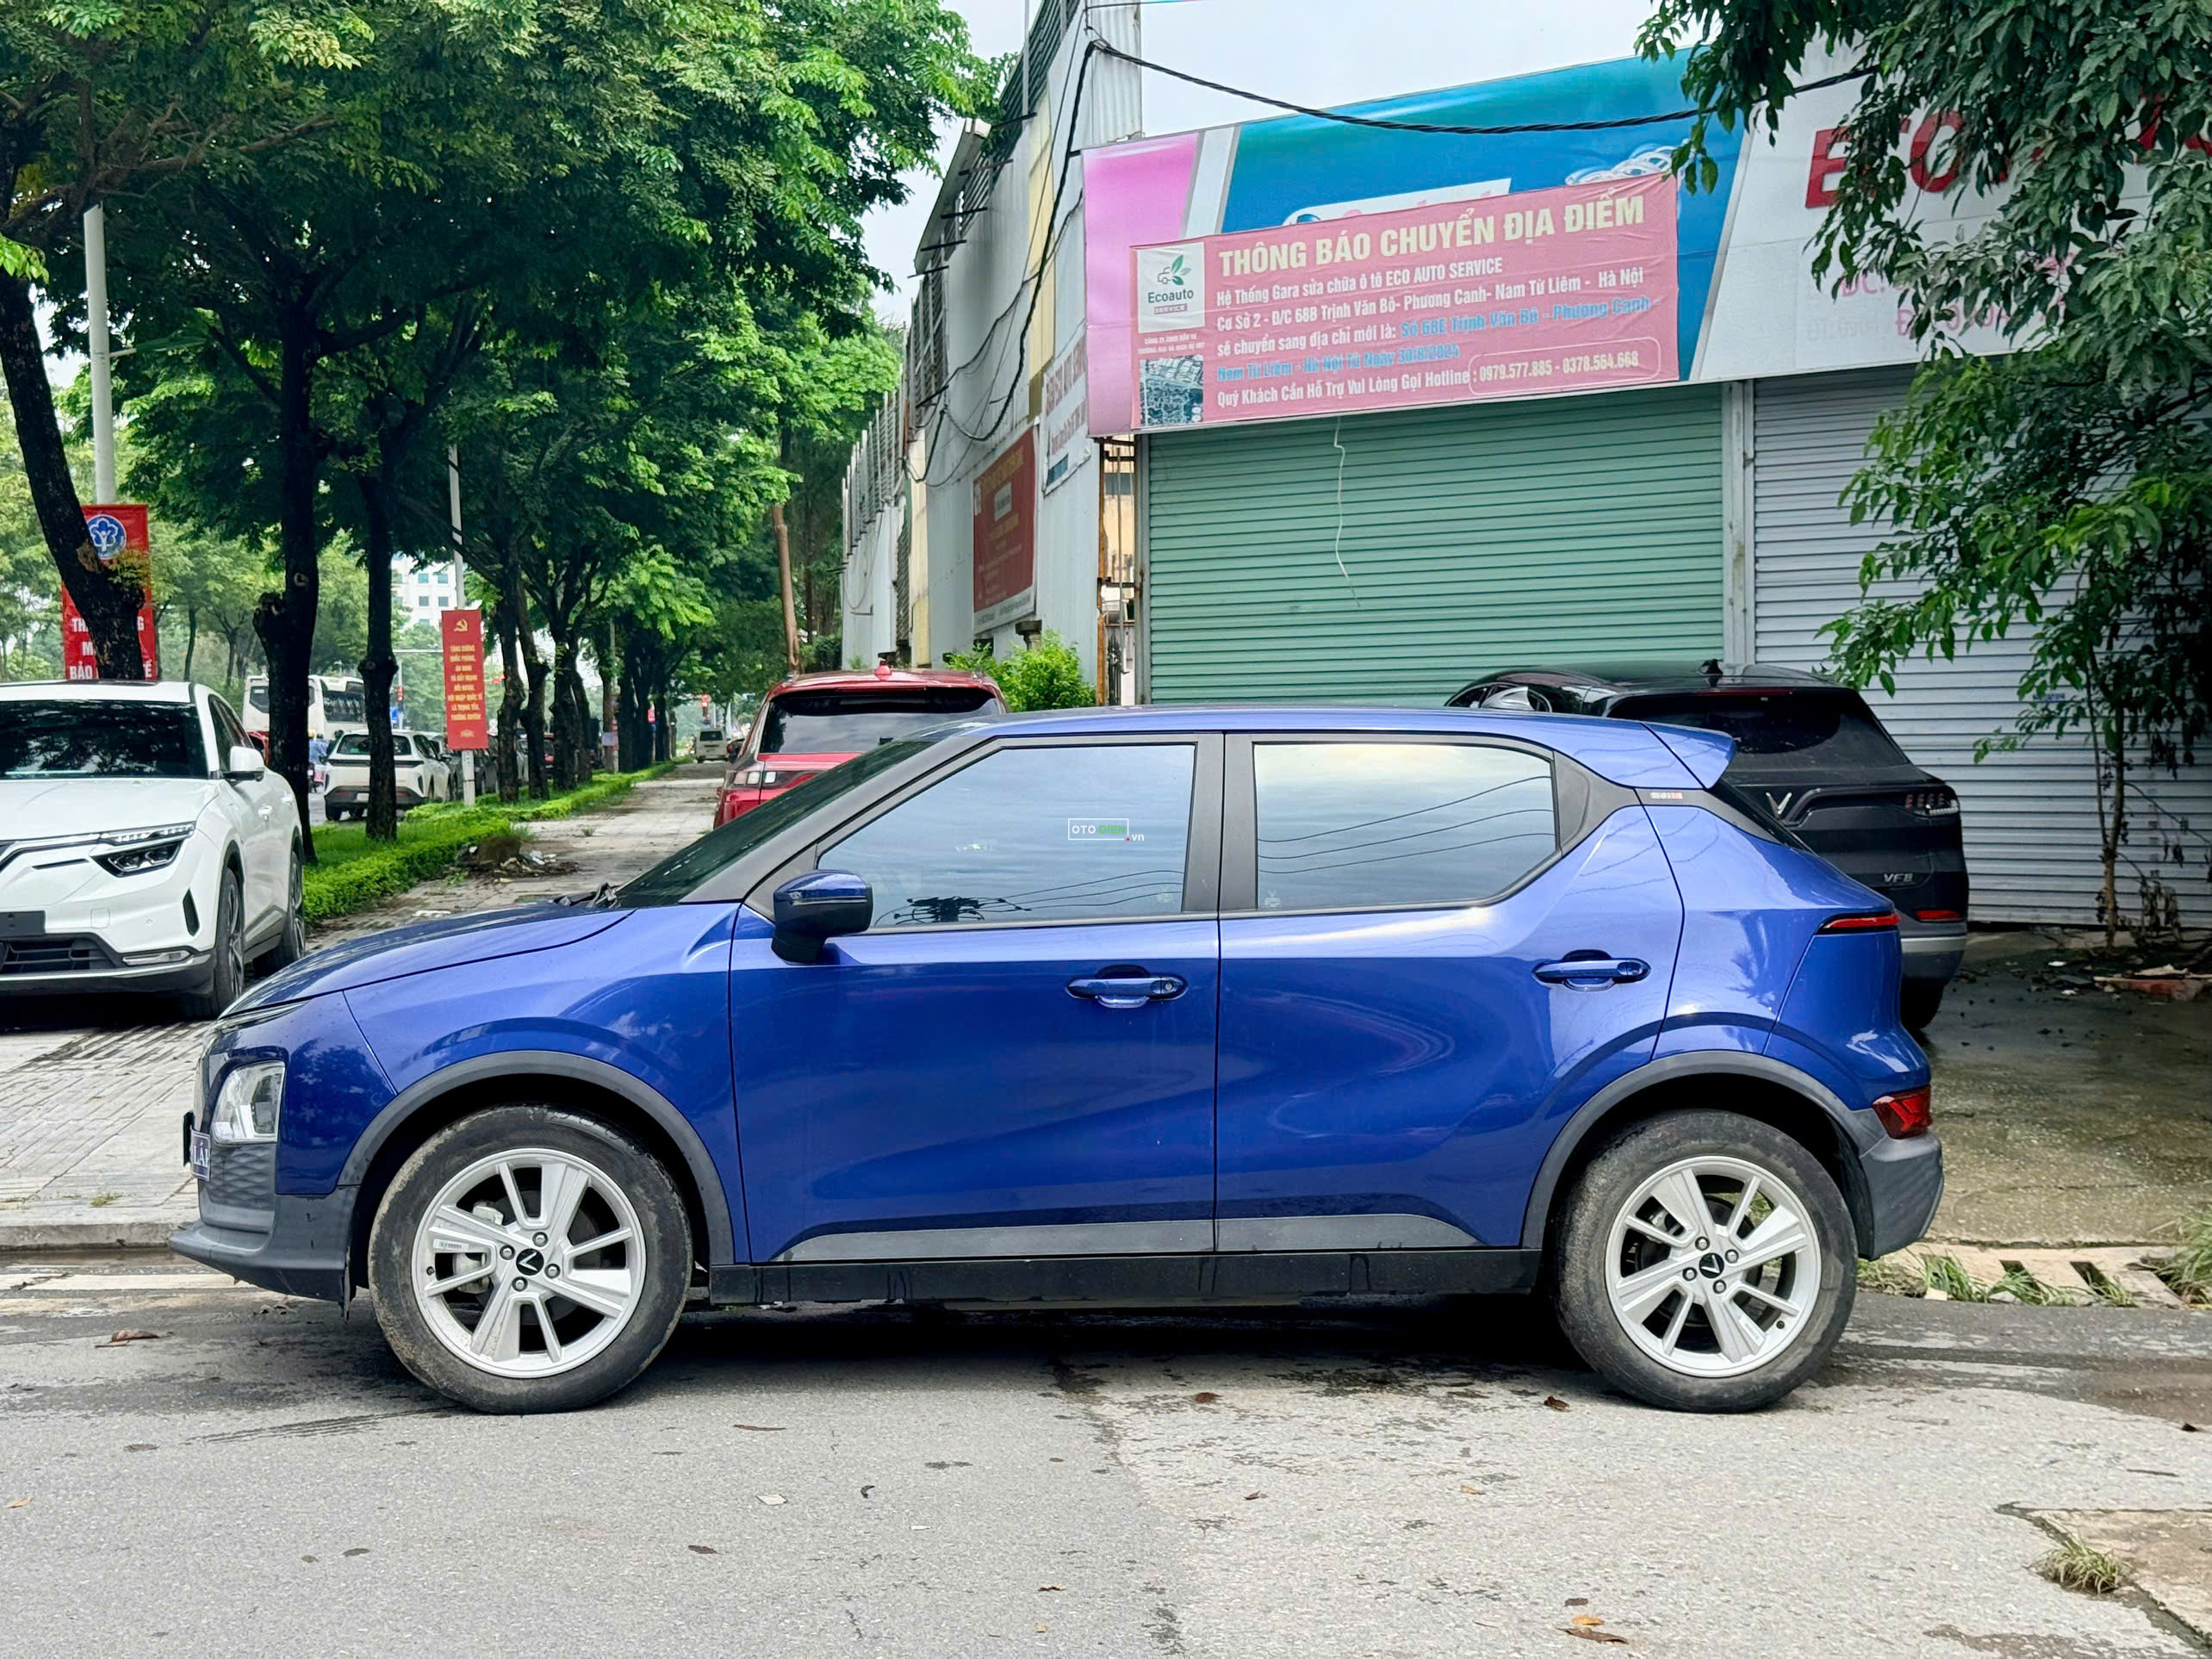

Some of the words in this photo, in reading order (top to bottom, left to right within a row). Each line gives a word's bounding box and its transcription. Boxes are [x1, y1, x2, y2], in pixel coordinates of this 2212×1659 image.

[1219, 241, 1307, 276] THÔNG
[1315, 230, 1371, 265] BÁO
[1380, 208, 1495, 257] CHUYỂN
[1503, 208, 1555, 244] ĐỊA
[1563, 187, 1644, 233] ĐIỂM
[1147, 289, 1194, 303] Ecoauto
[1216, 290, 1232, 308] Hệ
[1234, 284, 1270, 304] Thống
[1272, 284, 1299, 301] Gara
[1370, 271, 1382, 288] tô
[1385, 268, 1411, 287] ECO
[1414, 264, 1446, 283] AUTO
[1449, 257, 1503, 279] SERVICE
[1216, 314, 1233, 332] Cơ
[1253, 313, 1262, 328] 2
[1271, 308, 1292, 326] Đ/C
[1295, 306, 1318, 323] 68B
[1320, 302, 1351, 323] Trịnh
[1353, 298, 1376, 315] Văn
[1494, 283, 1525, 301] Nam
[1548, 275, 1581, 295] Liêm
[1598, 270, 1616, 289] Hà
[1619, 266, 1643, 288] Nội
[1233, 333, 1276, 356] chuyển
[1278, 335, 1307, 351] sang
[1309, 330, 1328, 350] địa
[1354, 324, 1376, 341] mới
[1380, 323, 1396, 339] là:
[1612, 295, 1651, 315] Canh
[1241, 387, 1278, 405] Khách
[1347, 378, 1365, 395] Vui
[1369, 376, 1398, 394] Lòng
[1401, 373, 1421, 392] Gọi
[1425, 369, 1469, 388] Hotline
[69, 661, 93, 680] BẢO
